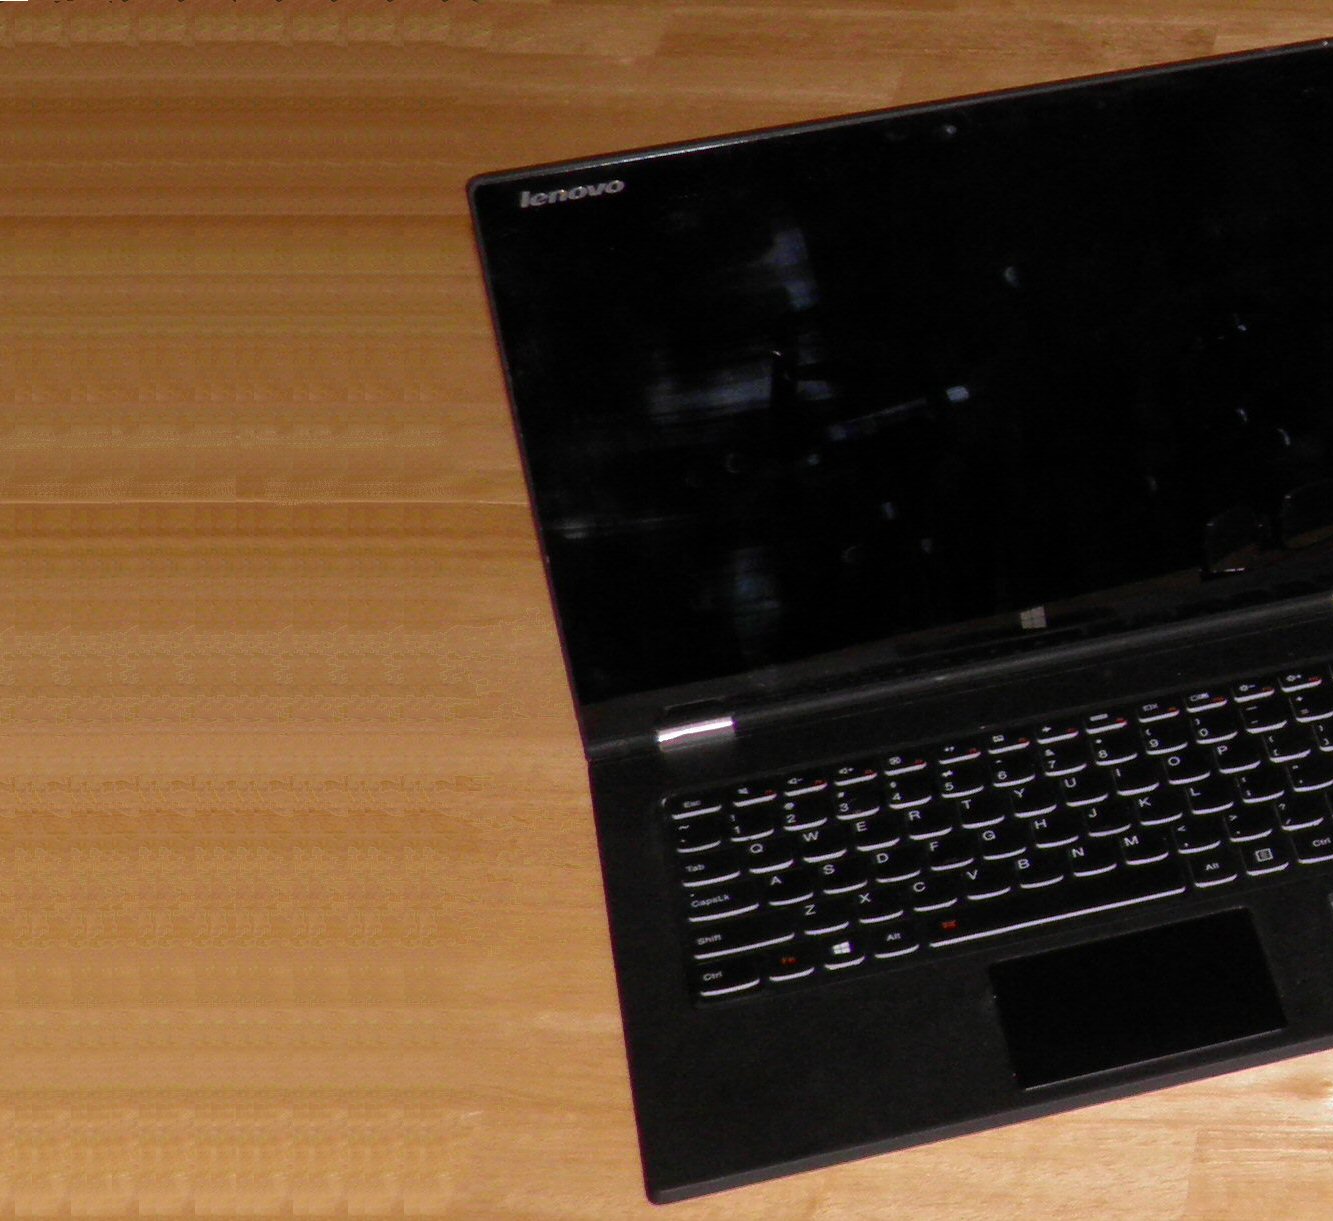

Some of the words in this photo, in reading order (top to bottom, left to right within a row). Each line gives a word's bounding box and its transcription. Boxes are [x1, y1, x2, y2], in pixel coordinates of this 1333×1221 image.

[521, 180, 624, 208] lenovo
[1150, 739, 1159, 748] 9
[1099, 750, 1108, 759] 8
[1217, 745, 1228, 756] P
[1048, 760, 1057, 769] 7
[1168, 756, 1181, 767] O
[997, 771, 1007, 780] 6
[945, 782, 954, 791] 5
[1064, 777, 1077, 788] U
[892, 793, 901, 801] 4
[1014, 788, 1025, 798] Y
[1190, 787, 1201, 797] L
[961, 799, 972, 809] T
[1138, 797, 1151, 807] K
[840, 803, 849, 812] 3
[908, 810, 921, 821] R
[1088, 808, 1098, 818] J
[786, 814, 796, 824] 2
[856, 821, 868, 832] E
[1034, 819, 1047, 830] H
[803, 831, 819, 842] W
[982, 831, 996, 841] G
[1124, 835, 1140, 847] M
[930, 841, 940, 851] F
[1312, 837, 1331, 847] Ctrl
[750, 843, 764, 854] Q
[1072, 847, 1085, 858] N
[876, 853, 889, 863] D
[685, 864, 705, 873] Tab
[1018, 859, 1030, 869] B
[1205, 862, 1220, 872] Alt
[823, 864, 835, 875] S
[966, 869, 978, 880] V
[770, 875, 782, 886] A
[913, 882, 926, 893] C
[859, 893, 871, 904] X
[805, 904, 816, 916] Z
[696, 934, 722, 945] Shift
[886, 933, 901, 942] Alt
[703, 971, 722, 982] Ctrl
